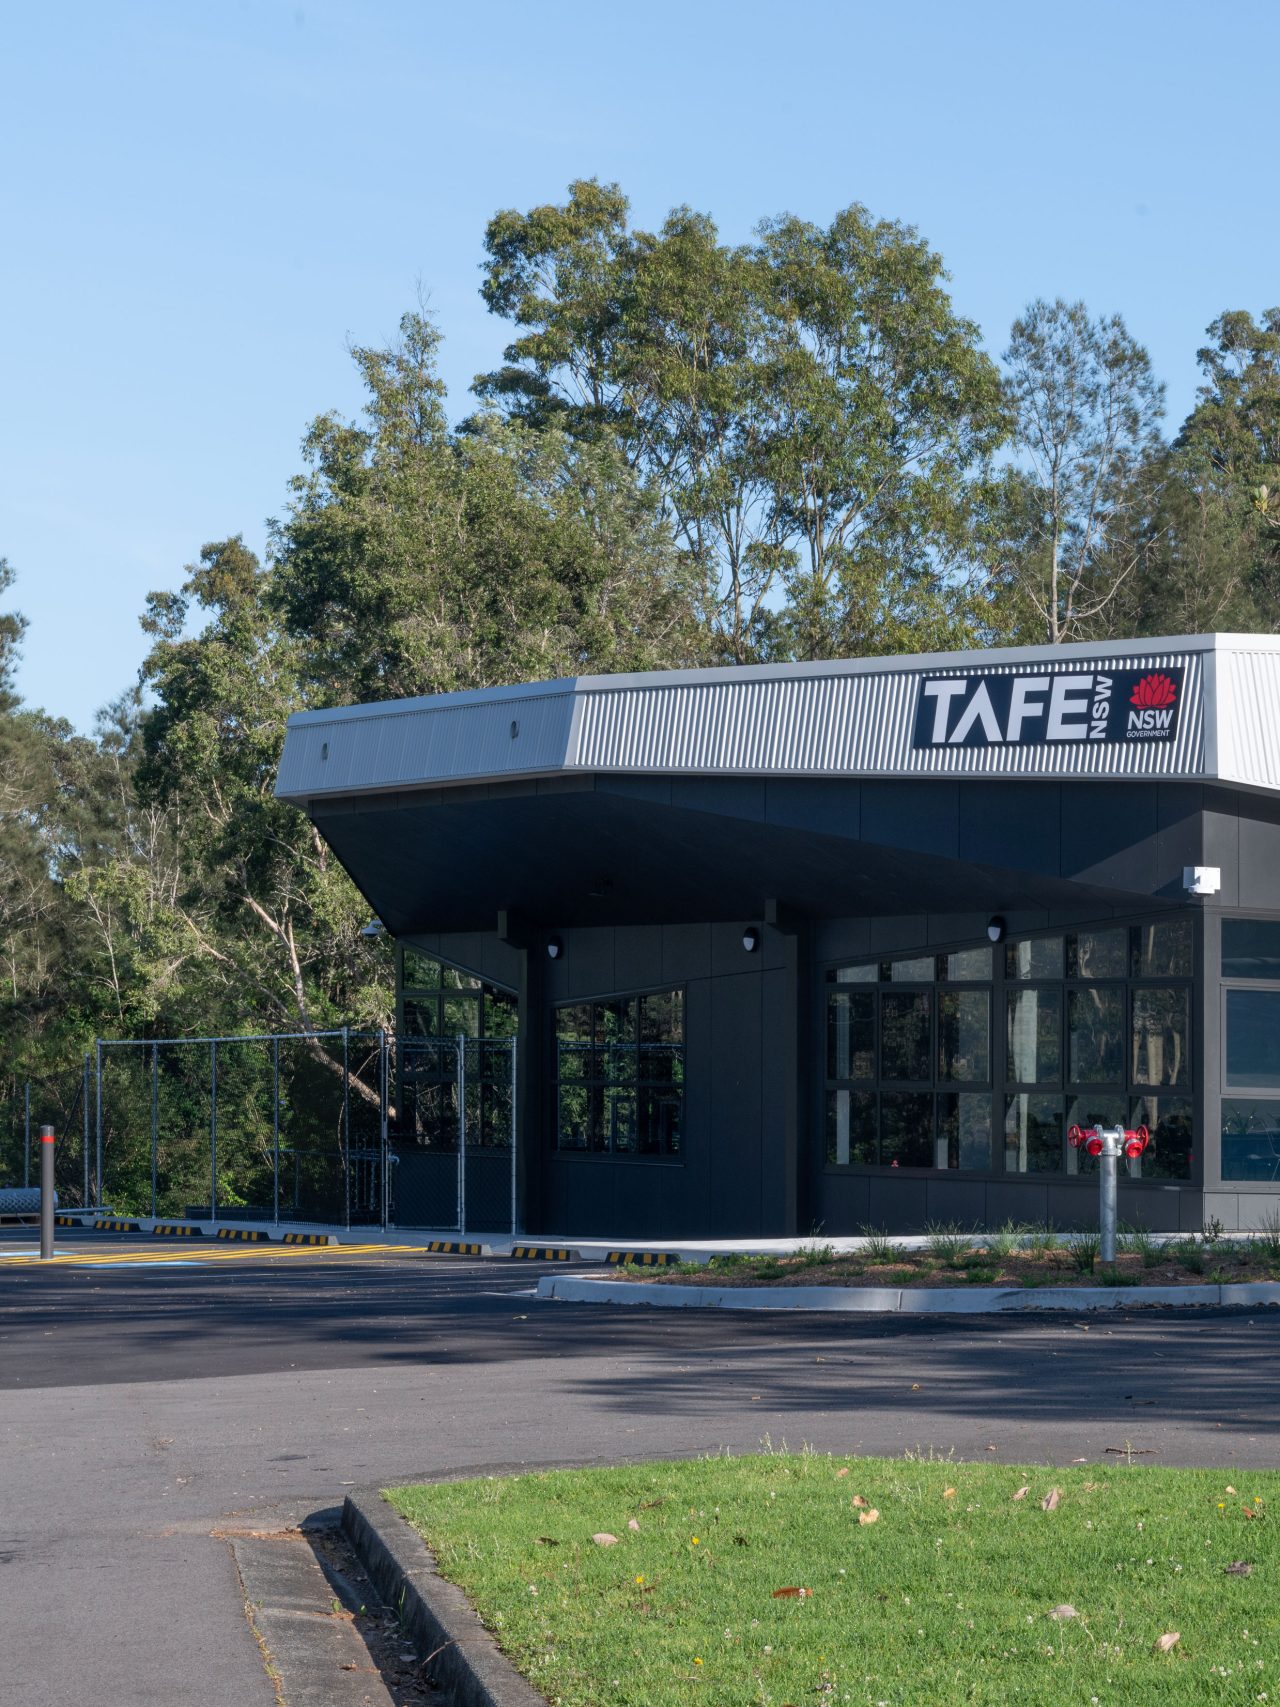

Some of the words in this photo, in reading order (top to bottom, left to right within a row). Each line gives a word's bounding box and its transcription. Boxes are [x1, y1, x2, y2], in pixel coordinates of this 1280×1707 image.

[924, 675, 1094, 743] TAFE
[1089, 675, 1113, 739] NSW
[1127, 709, 1174, 730] NSW
[1126, 729, 1170, 738] GOVERNMENT
